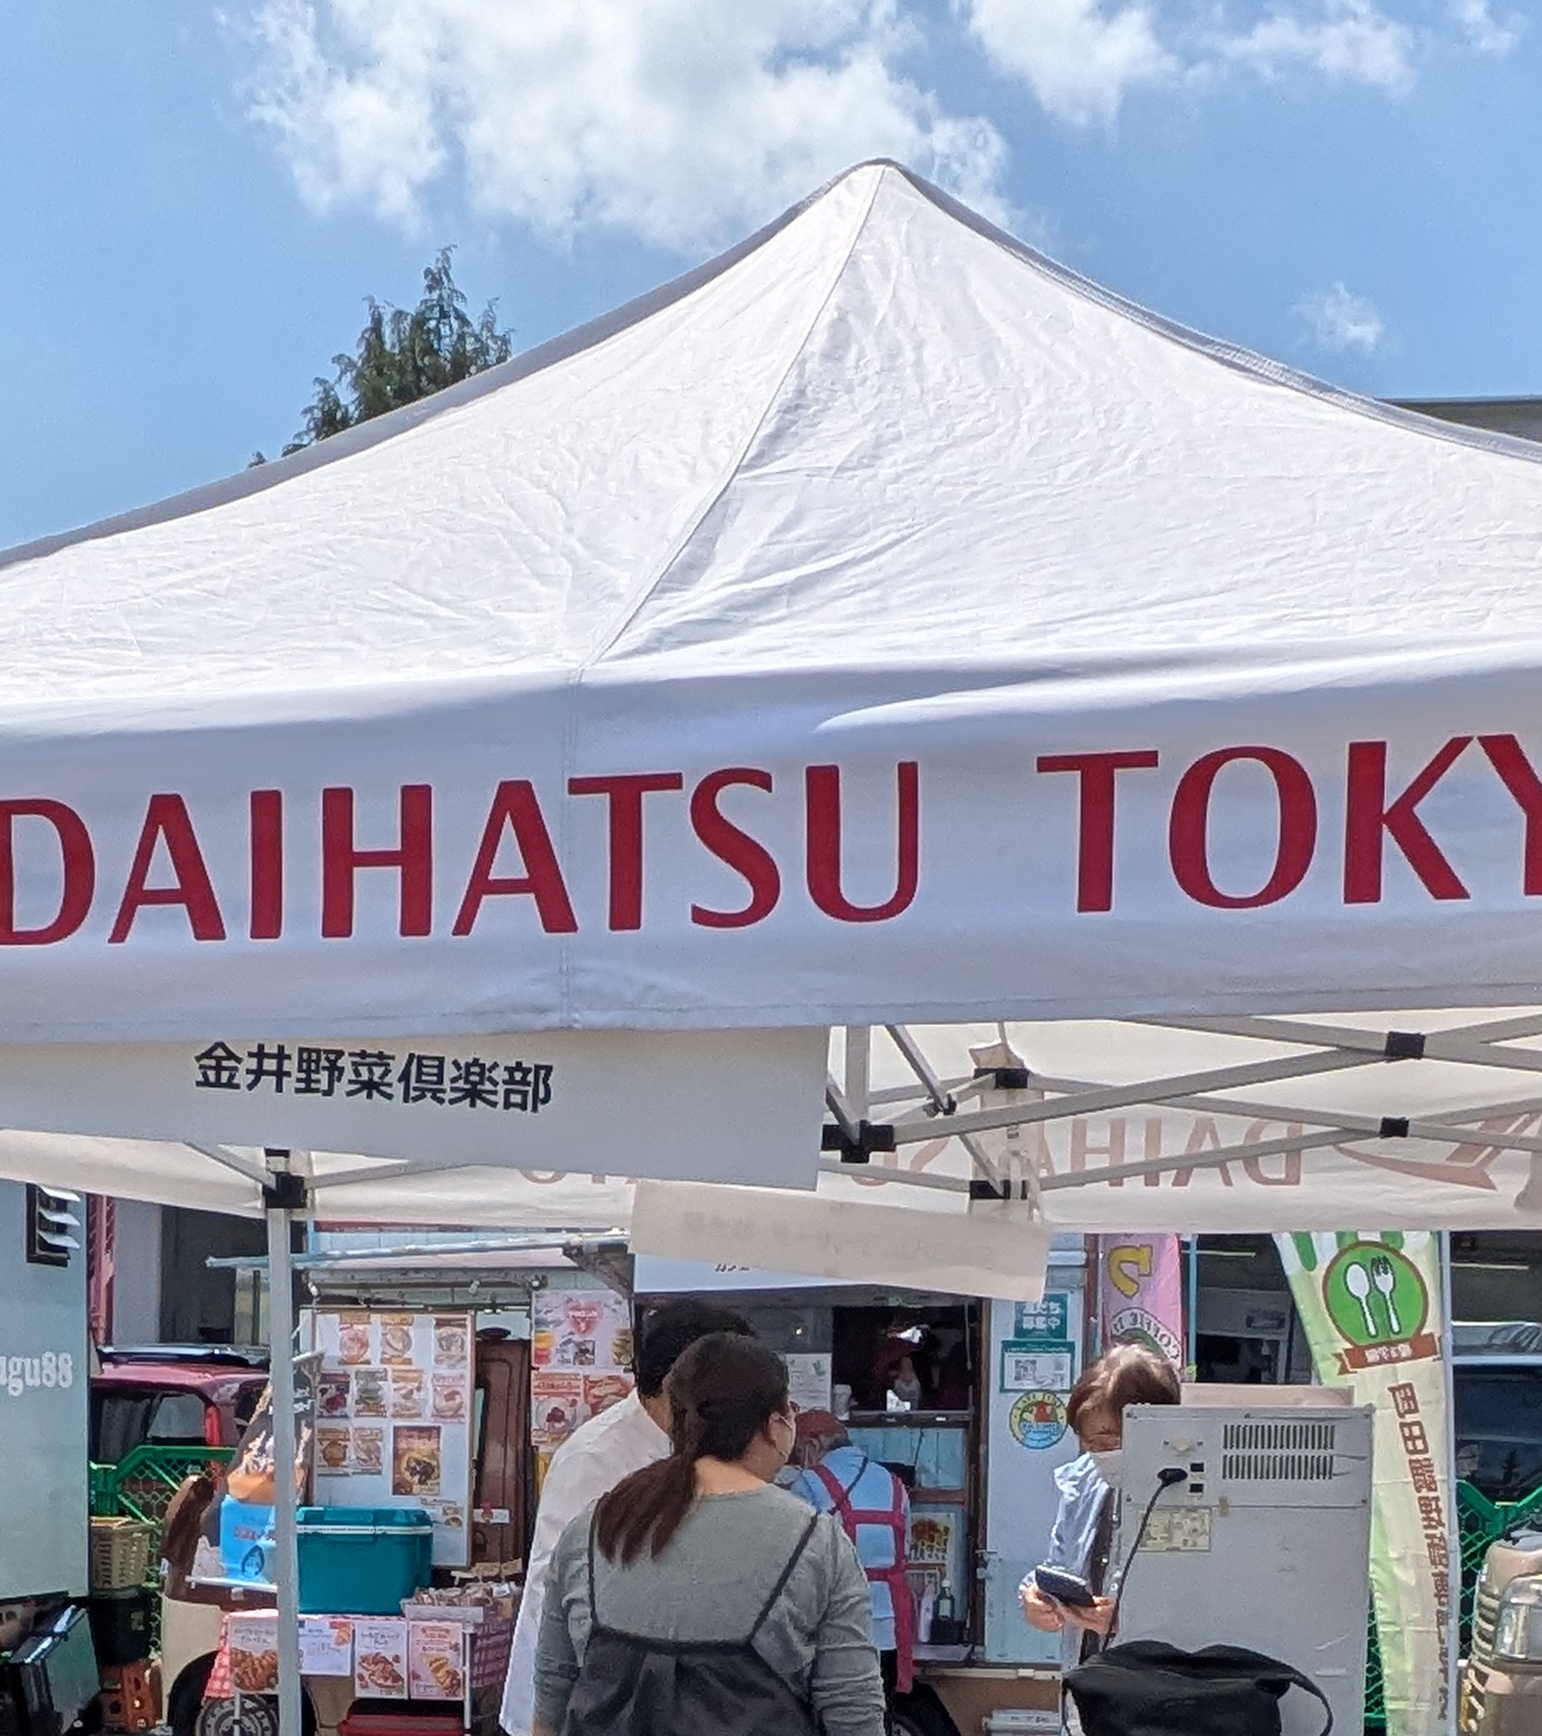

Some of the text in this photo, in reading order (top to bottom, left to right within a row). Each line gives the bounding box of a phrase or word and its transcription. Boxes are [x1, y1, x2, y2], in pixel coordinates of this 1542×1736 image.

[194, 1041, 554, 1113] 金井野菜倶楽部
